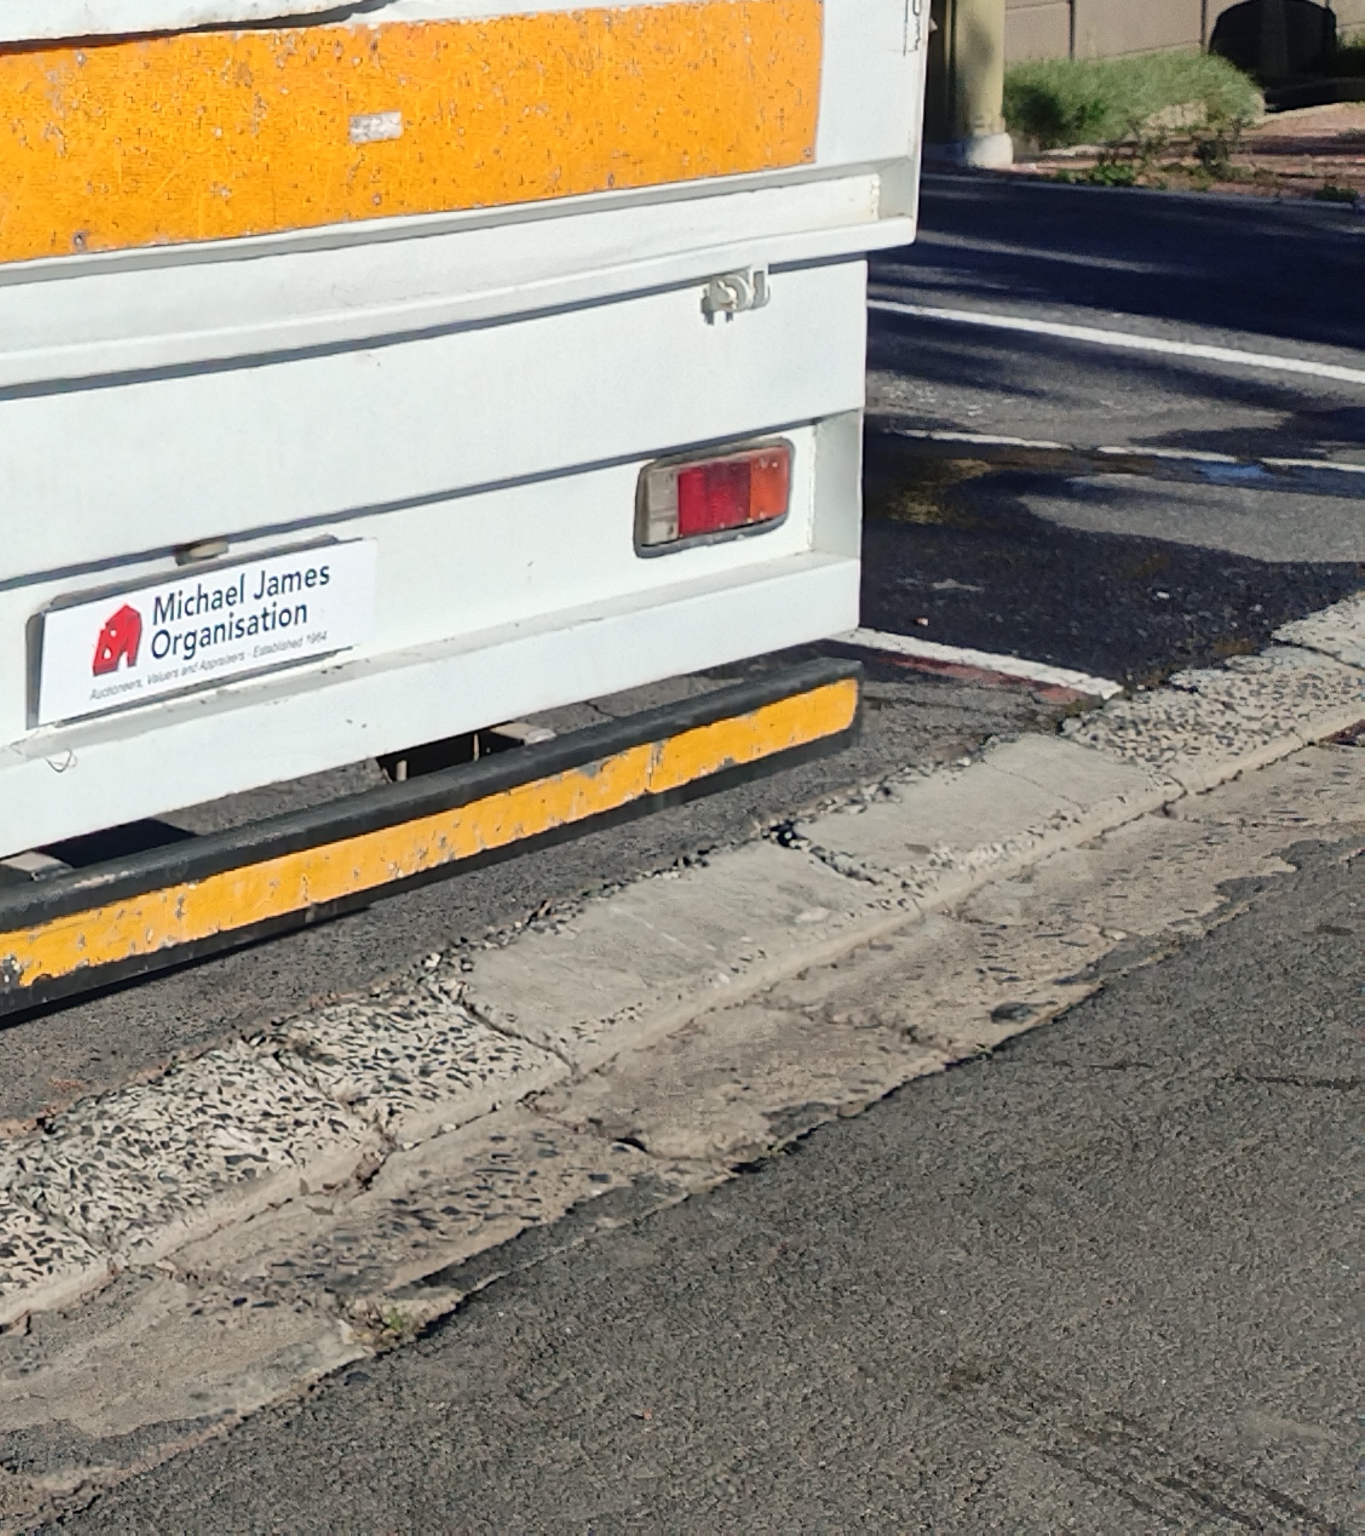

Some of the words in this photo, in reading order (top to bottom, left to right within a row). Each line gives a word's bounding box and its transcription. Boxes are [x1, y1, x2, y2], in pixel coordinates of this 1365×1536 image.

[152, 572, 246, 626] Michael
[253, 565, 331, 600] James
[151, 601, 309, 661] Organisation
